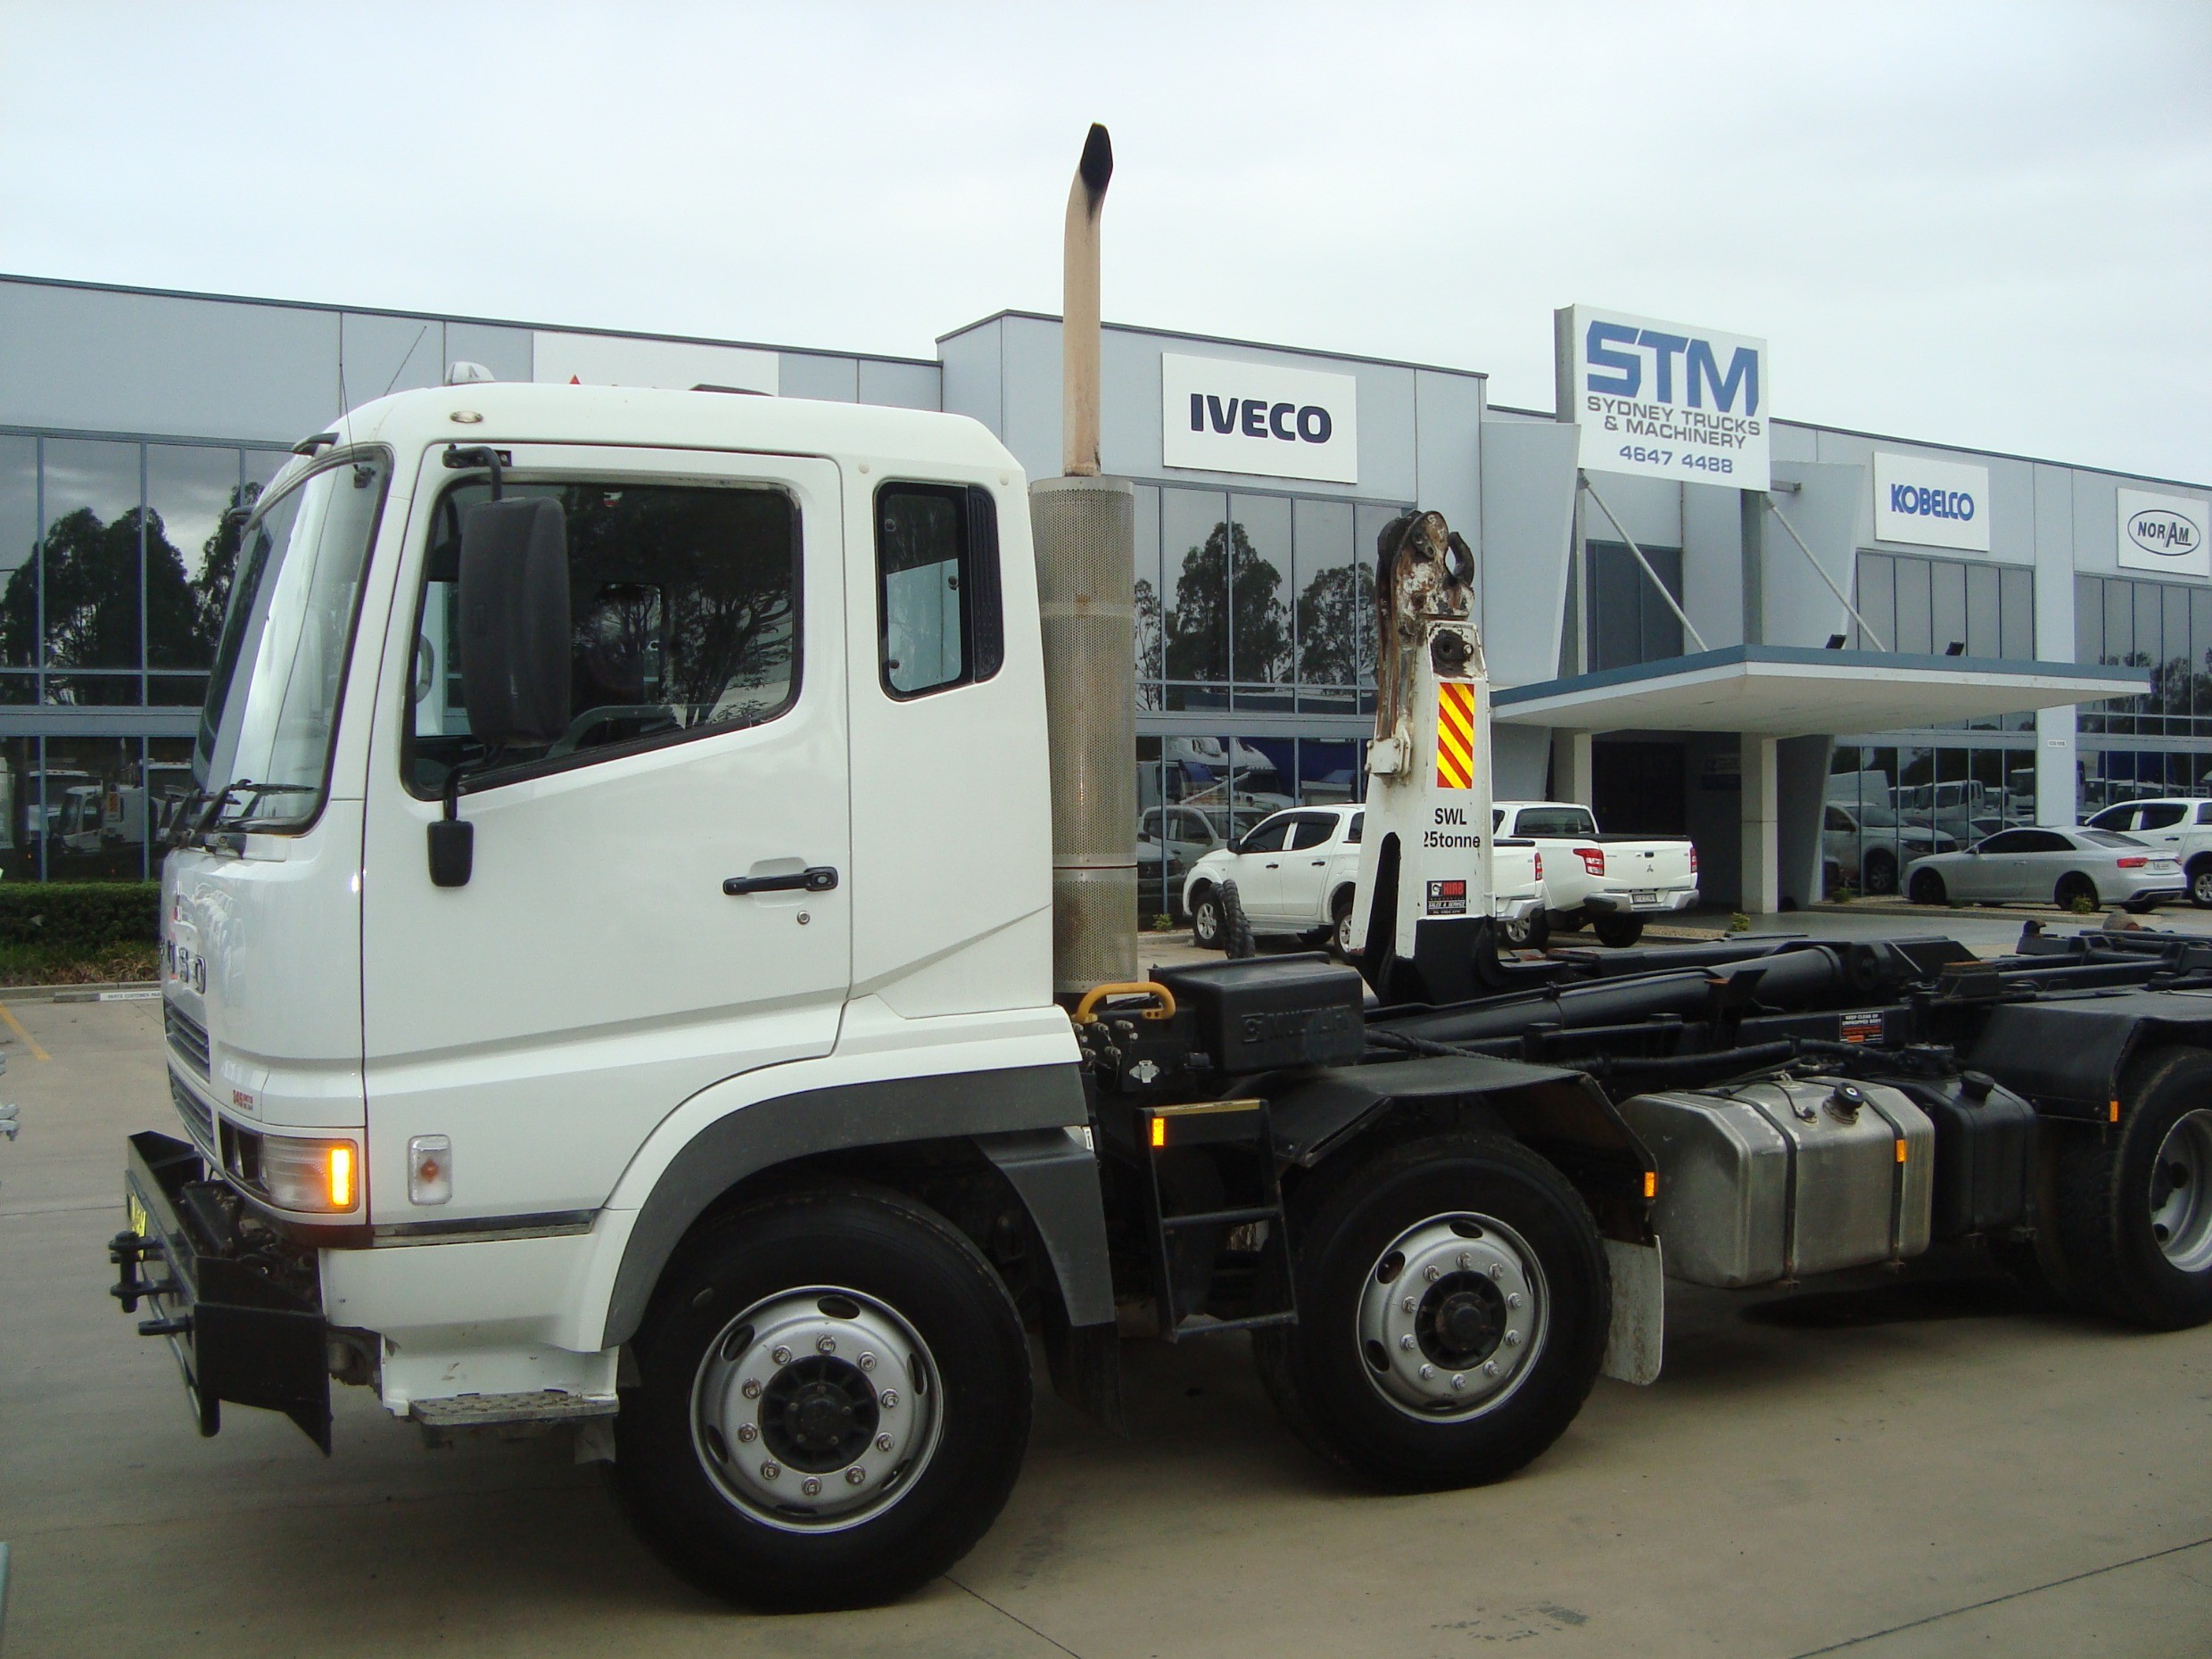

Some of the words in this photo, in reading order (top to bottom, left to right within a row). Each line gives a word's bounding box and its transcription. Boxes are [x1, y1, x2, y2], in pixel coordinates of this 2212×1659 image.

[1587, 320, 1759, 417] STM
[1191, 393, 1332, 443] IVECO
[1588, 396, 1674, 423] SYDNEY
[1681, 410, 1761, 436] TRUCKS
[1604, 416, 1619, 431] &
[1626, 418, 1746, 449] MACHINERY
[1620, 446, 1672, 466] 4647
[1681, 454, 1733, 474] 4488
[1890, 483, 1975, 522] KOBELCO
[1434, 808, 1467, 825] SWL
